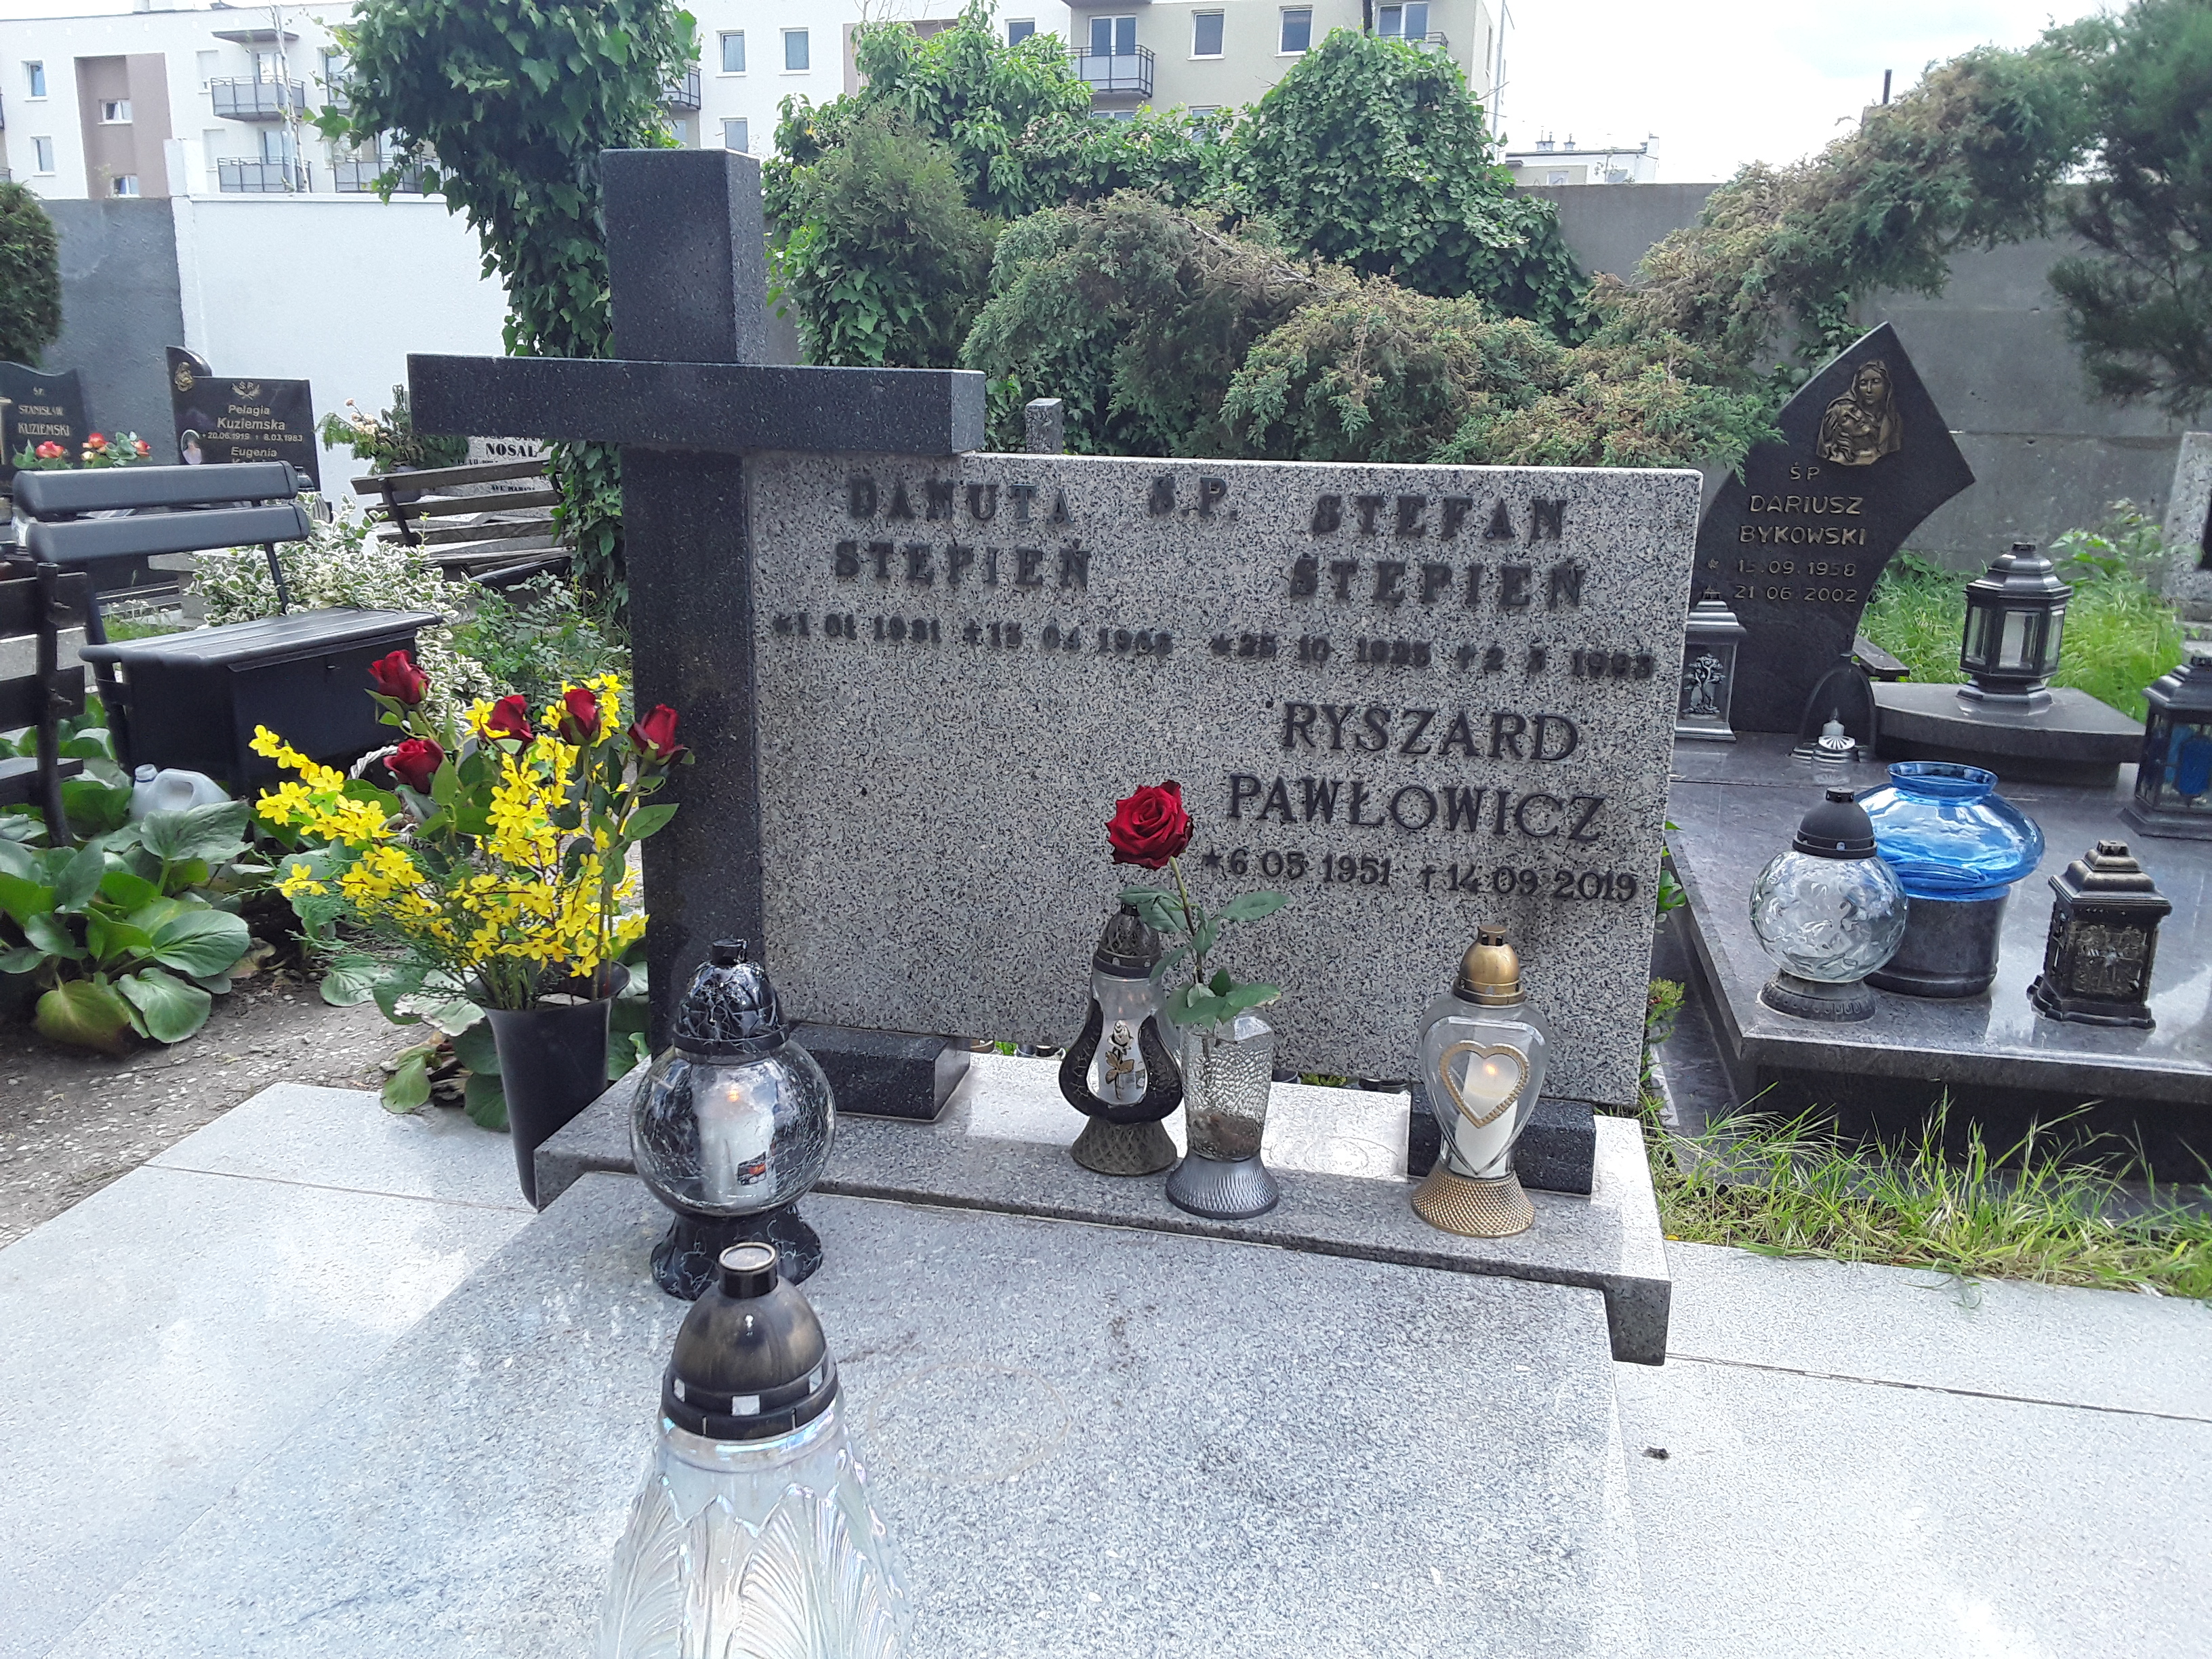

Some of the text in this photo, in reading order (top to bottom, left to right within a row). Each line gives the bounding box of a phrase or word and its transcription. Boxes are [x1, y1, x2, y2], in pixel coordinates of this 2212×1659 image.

[228, 405, 270, 417] Pelagia
[18, 422, 70, 437] KUZIEMSKI
[217, 417, 286, 431] Kuziemska
[230, 445, 278, 459] Eugenia
[850, 477, 1077, 523] DANUTA
[1750, 495, 1863, 516] DARIUSZ
[1311, 494, 1567, 540] STEFAN
[1740, 525, 1866, 546] BYKOWSKI
[1803, 587, 1858, 603] 2002
[1286, 700, 1579, 762] RYSZARD
[1228, 771, 1607, 841] PAWŁOWICZ
[1229, 848, 1248, 875] 6
[1262, 849, 1306, 879] 05
[1322, 851, 1390, 886] 1951
[1493, 865, 1538, 897] 09
[1554, 870, 1637, 903] 2019
